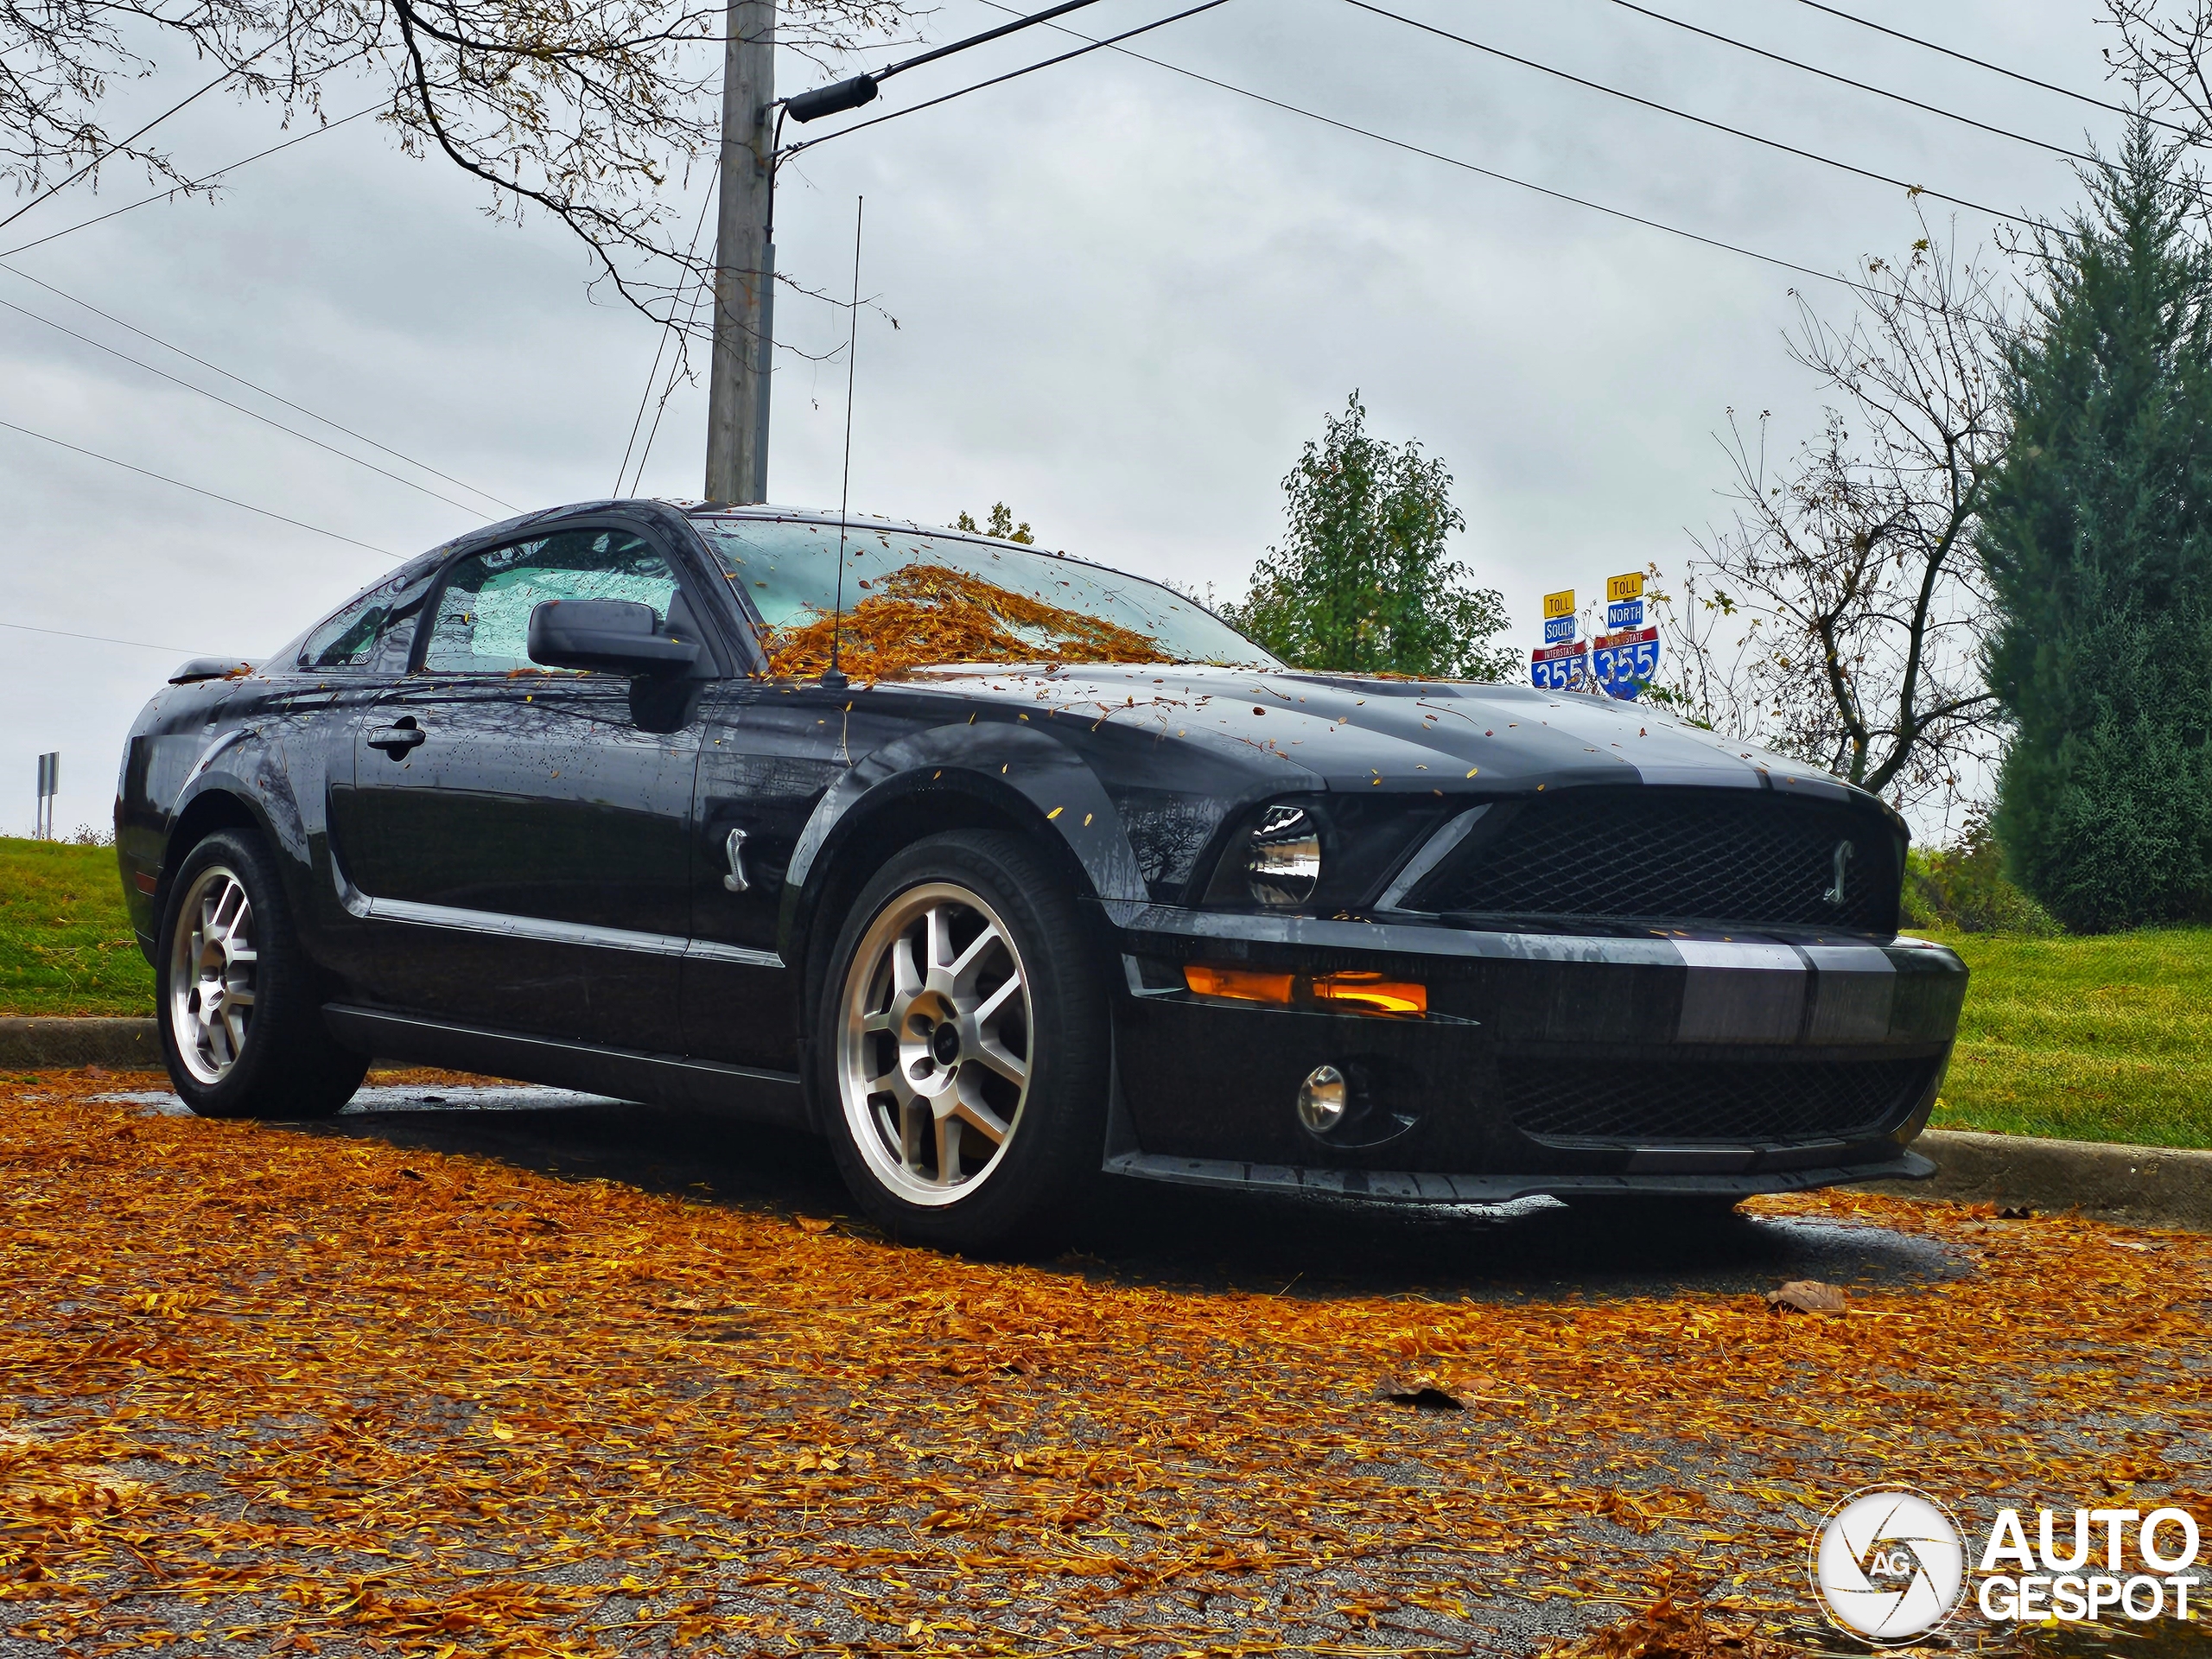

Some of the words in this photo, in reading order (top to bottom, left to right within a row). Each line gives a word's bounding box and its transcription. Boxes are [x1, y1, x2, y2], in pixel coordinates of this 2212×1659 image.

[1612, 580, 1637, 596] TOLL
[1549, 598, 1571, 613] TOLL
[1610, 606, 1642, 624] NORTH
[1546, 621, 1573, 639] SOUTH
[1544, 646, 1575, 659] INTERSTATE
[1599, 645, 1654, 685] 355
